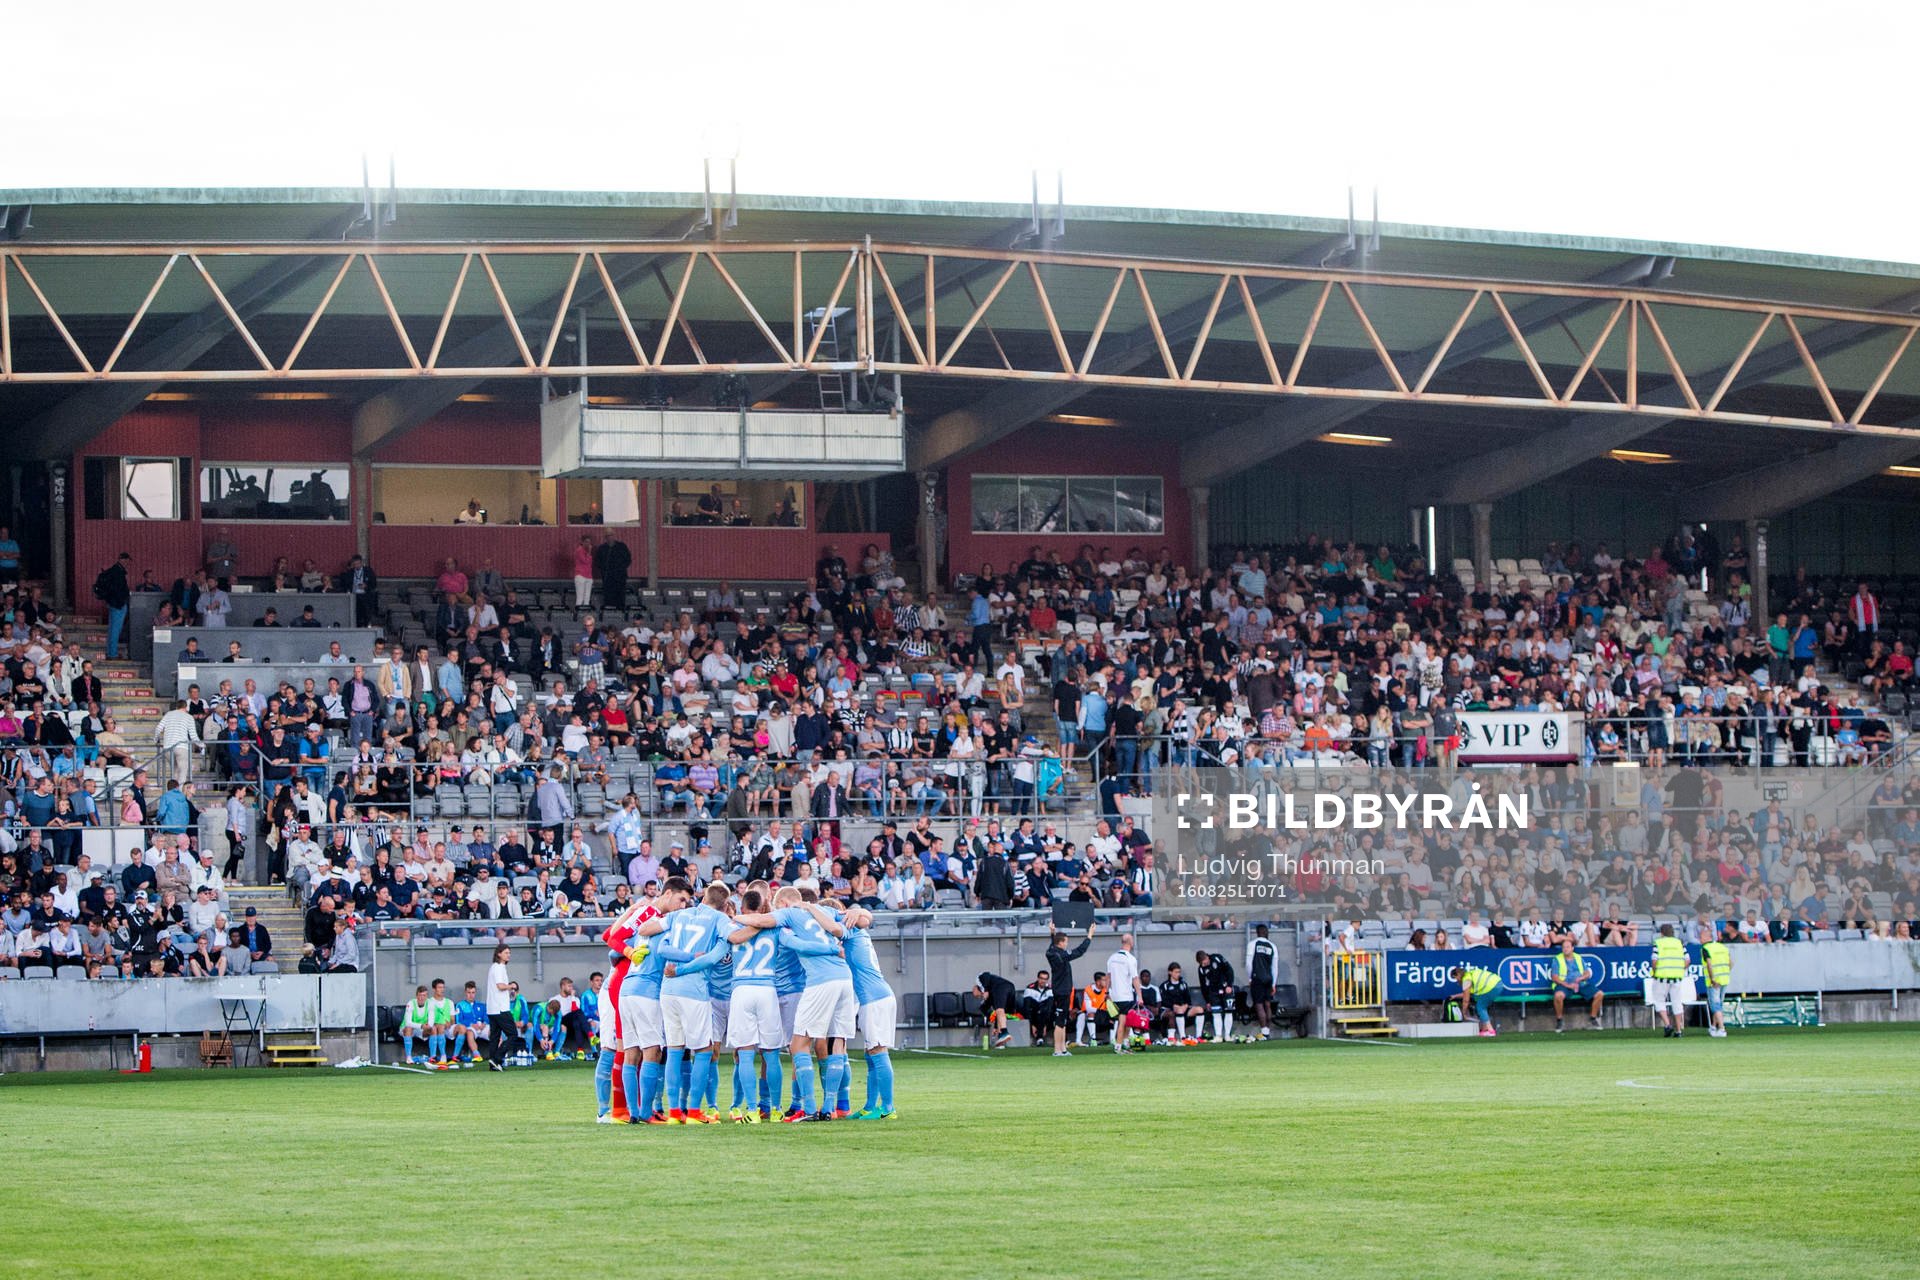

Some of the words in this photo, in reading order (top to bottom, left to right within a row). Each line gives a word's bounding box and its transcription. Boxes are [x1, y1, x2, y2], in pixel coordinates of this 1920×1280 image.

[1481, 724, 1530, 747] VIP
[672, 922, 706, 953] 17
[732, 937, 775, 977] 22
